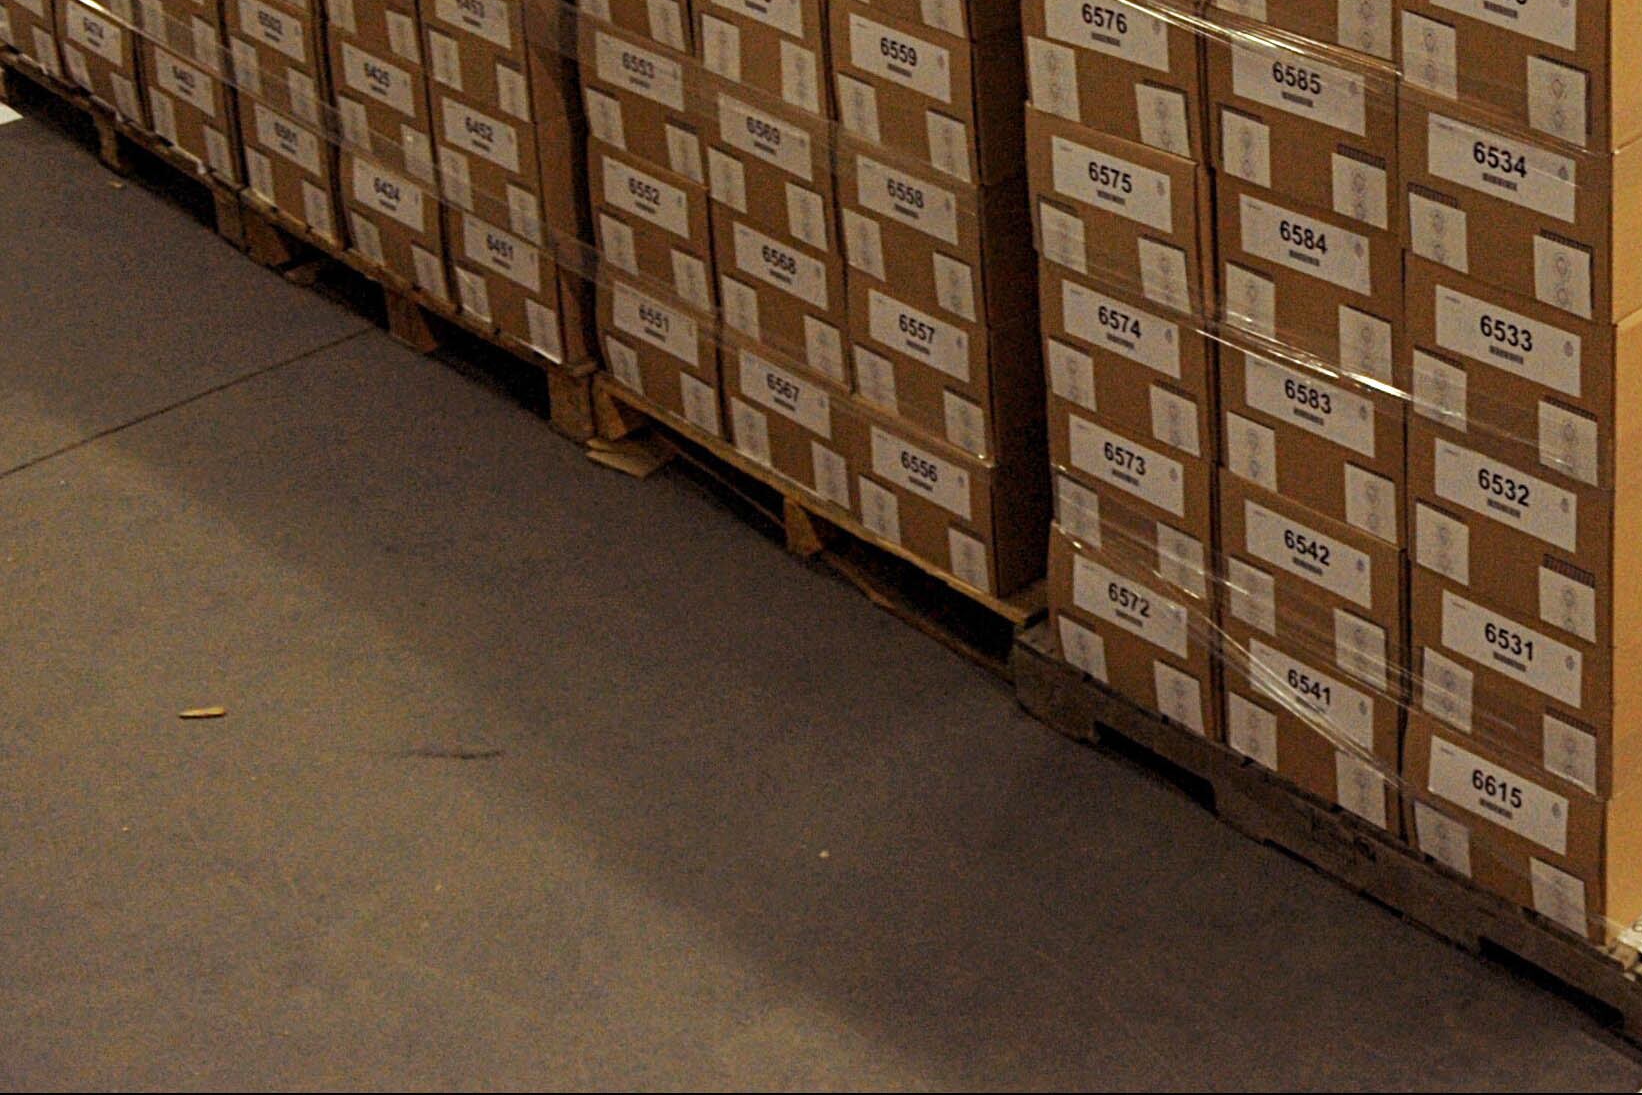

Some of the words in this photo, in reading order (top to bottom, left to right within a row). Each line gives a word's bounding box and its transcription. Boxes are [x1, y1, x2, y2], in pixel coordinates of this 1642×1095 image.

[1081, 3, 1128, 35] 6576
[880, 38, 917, 67] 6559
[1271, 61, 1322, 96] 6585
[1088, 161, 1133, 194] 6575
[1473, 142, 1527, 179] 6534
[628, 176, 660, 205] 6552
[886, 178, 924, 209] 6558
[1280, 220, 1327, 255] 6584
[762, 245, 796, 275] 6568
[899, 314, 935, 343] 6557
[1098, 306, 1141, 340] 6574
[1479, 315, 1533, 353] 6533
[767, 372, 800, 402] 6567
[1284, 379, 1332, 415] 6583
[901, 450, 938, 482] 6556
[1104, 441, 1146, 478] 6573
[1477, 468, 1530, 506] 6532
[1283, 529, 1331, 569] 6542
[1108, 581, 1151, 619] 6572
[1484, 623, 1535, 663] 6531
[1287, 669, 1332, 706] 6541
[1471, 769, 1522, 809] 6615
